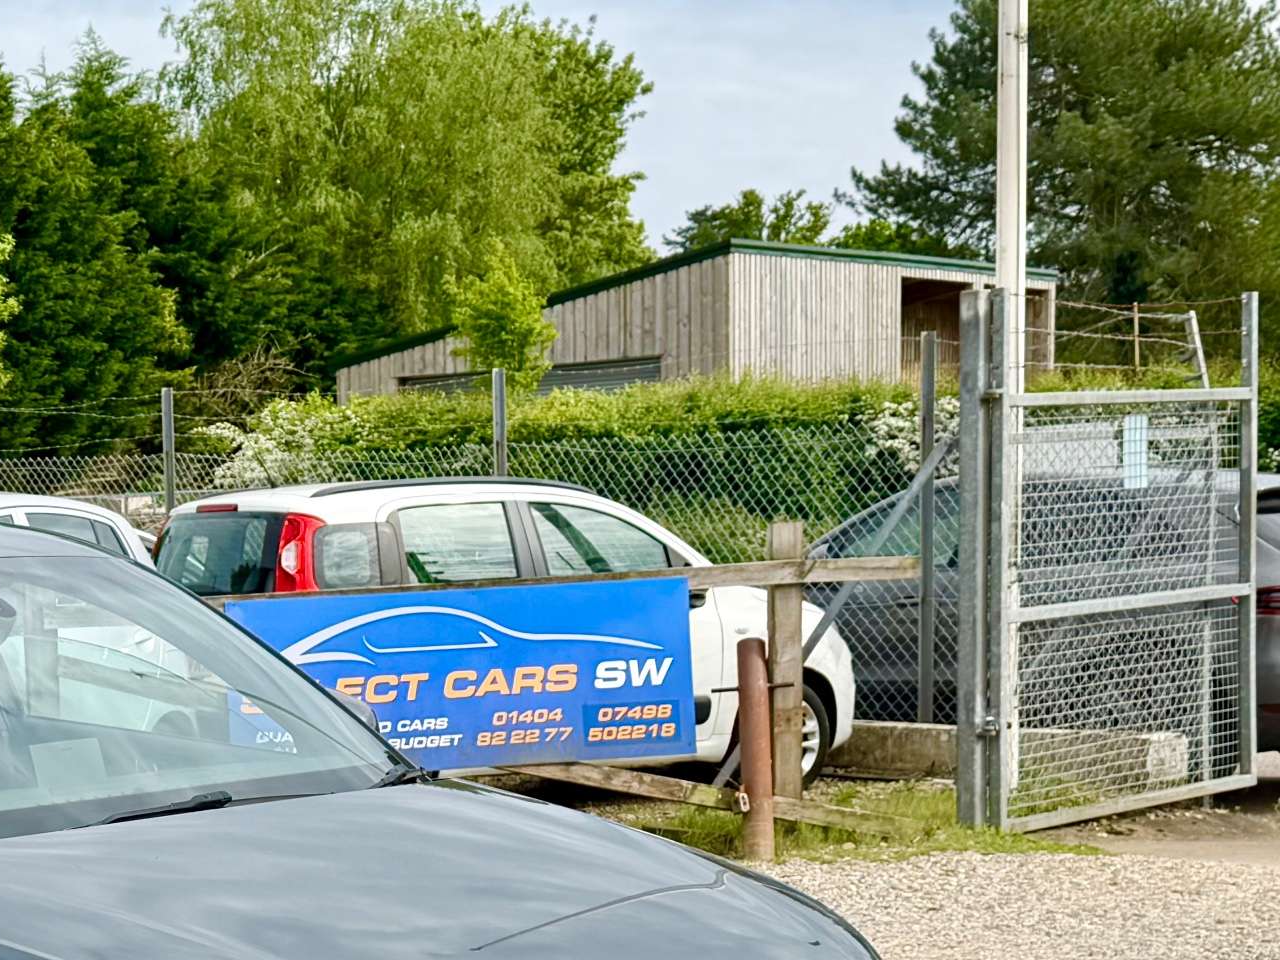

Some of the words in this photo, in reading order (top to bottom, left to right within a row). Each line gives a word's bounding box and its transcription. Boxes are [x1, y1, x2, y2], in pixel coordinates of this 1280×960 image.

[334, 672, 430, 704] ECT
[443, 664, 578, 699] CARS
[593, 657, 674, 689] SW
[396, 717, 449, 732] CARS
[492, 708, 563, 726] 01404
[588, 722, 676, 742] 502218
